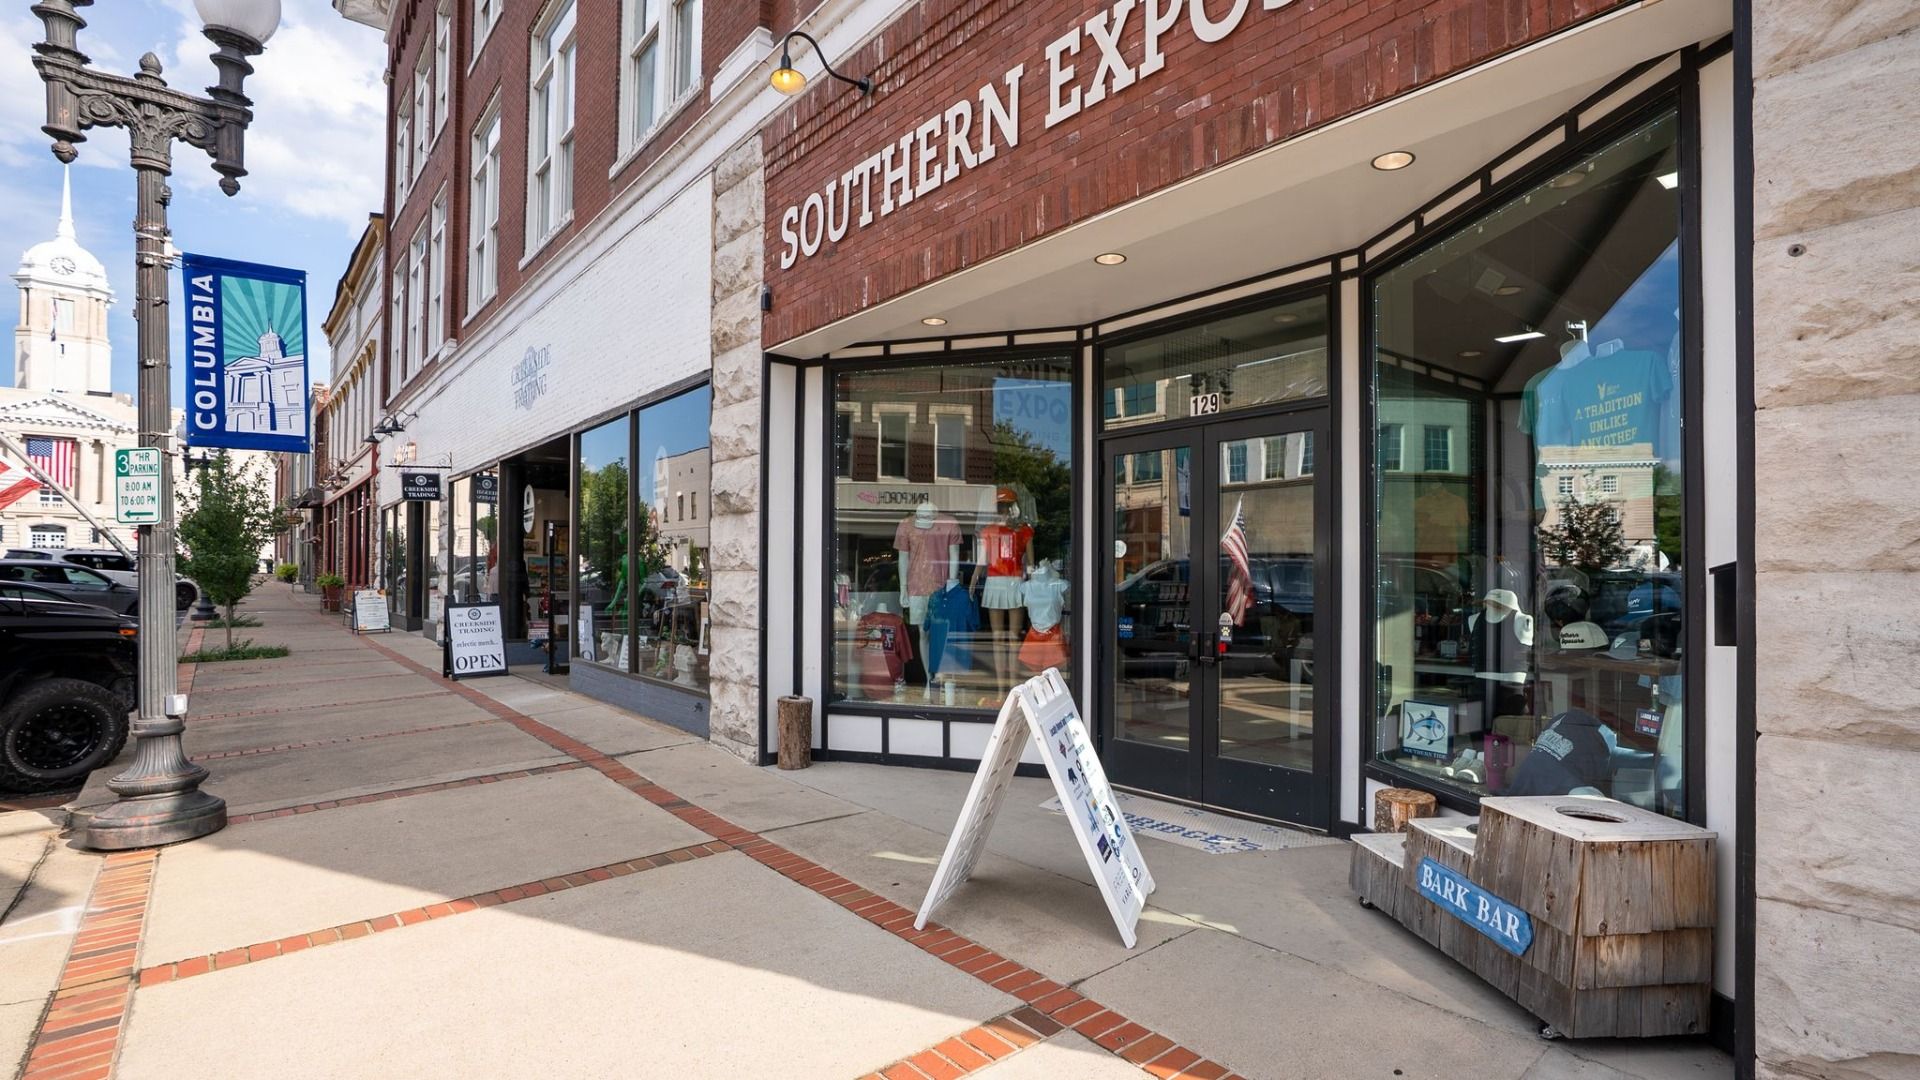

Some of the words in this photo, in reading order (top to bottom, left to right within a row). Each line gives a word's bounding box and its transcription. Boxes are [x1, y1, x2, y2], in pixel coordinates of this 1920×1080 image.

[781, 63, 1024, 270] SOUTHERN
[1045, 0, 1295, 129] EXPO
[191, 274, 218, 430] COLUMBIA
[1192, 393, 1218, 415] 129
[1585, 392, 1643, 419] TRADITION
[1589, 413, 1628, 434] UNLIKE
[118, 454, 129, 473] 3
[138, 452, 150, 462] HR
[130, 463, 158, 474] PARKING
[142, 481, 152, 491] AM
[120, 495, 129, 506] TO
[130, 495, 145, 506] 6:00
[147, 495, 156, 505] PM
[454, 620, 495, 628] CREEKSIDE
[455, 653, 502, 671] OPEN
[1420, 863, 1470, 912] BARK
[1476, 895, 1520, 943] BAR
